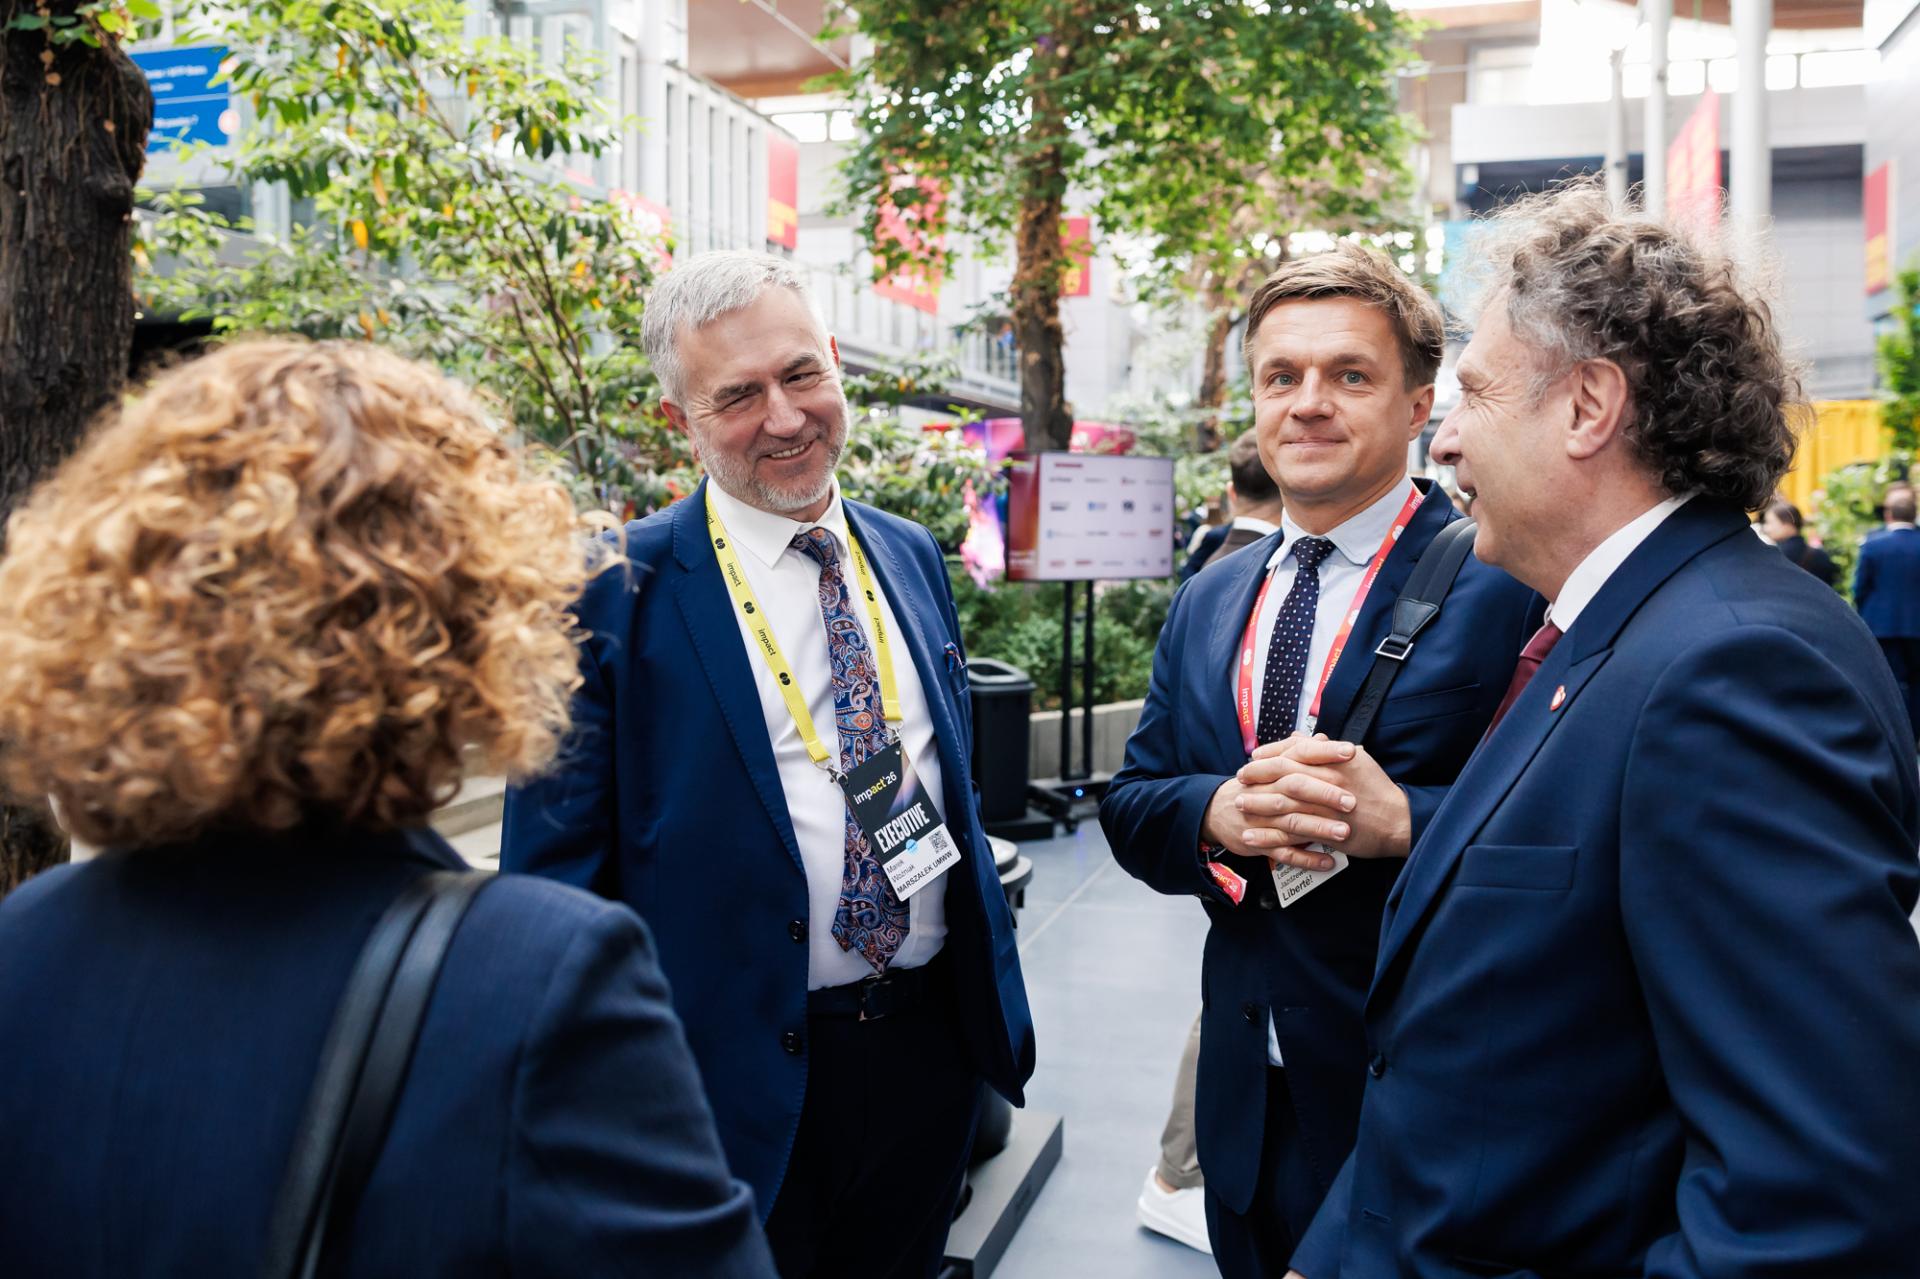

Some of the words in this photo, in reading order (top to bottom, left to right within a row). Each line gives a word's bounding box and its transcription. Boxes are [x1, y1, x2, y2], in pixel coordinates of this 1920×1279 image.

[727, 562, 742, 588] impact
[758, 628, 777, 656] impact
[1241, 687, 1251, 725] impact
[874, 802, 930, 854] EXECUTIVE
